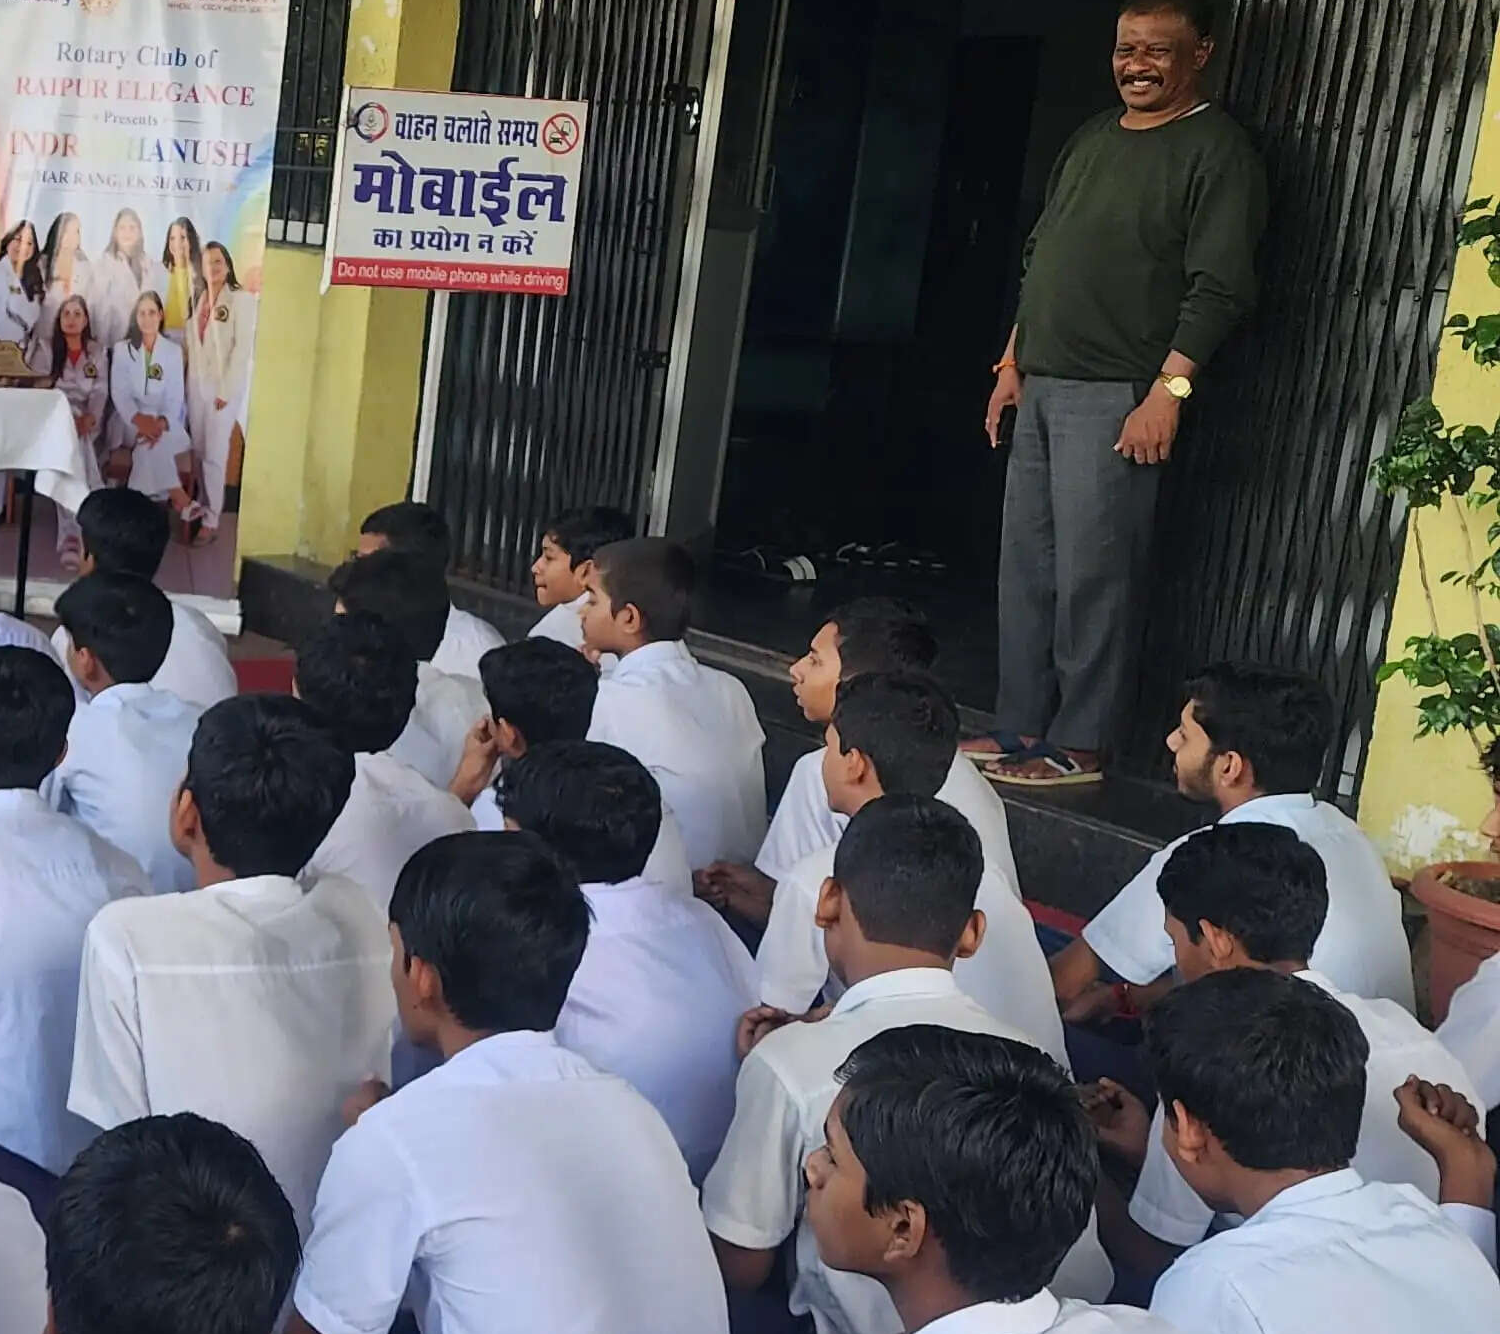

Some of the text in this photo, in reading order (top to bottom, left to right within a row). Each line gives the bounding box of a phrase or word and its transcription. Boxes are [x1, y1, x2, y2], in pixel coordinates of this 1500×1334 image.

[57, 42, 219, 69] Rotary Club of
[15, 76, 255, 107] RAIPUR ELEGANCE
[104, 110, 159, 126] Presents
[394, 110, 539, 148] वाहन चलाते समय
[10, 130, 253, 168] INDRHANUSH
[353, 150, 568, 227] मोबाईल
[373, 226, 539, 255] का प्रयोग न करें
[337, 262, 565, 291] Do not use mobile phone while driving
